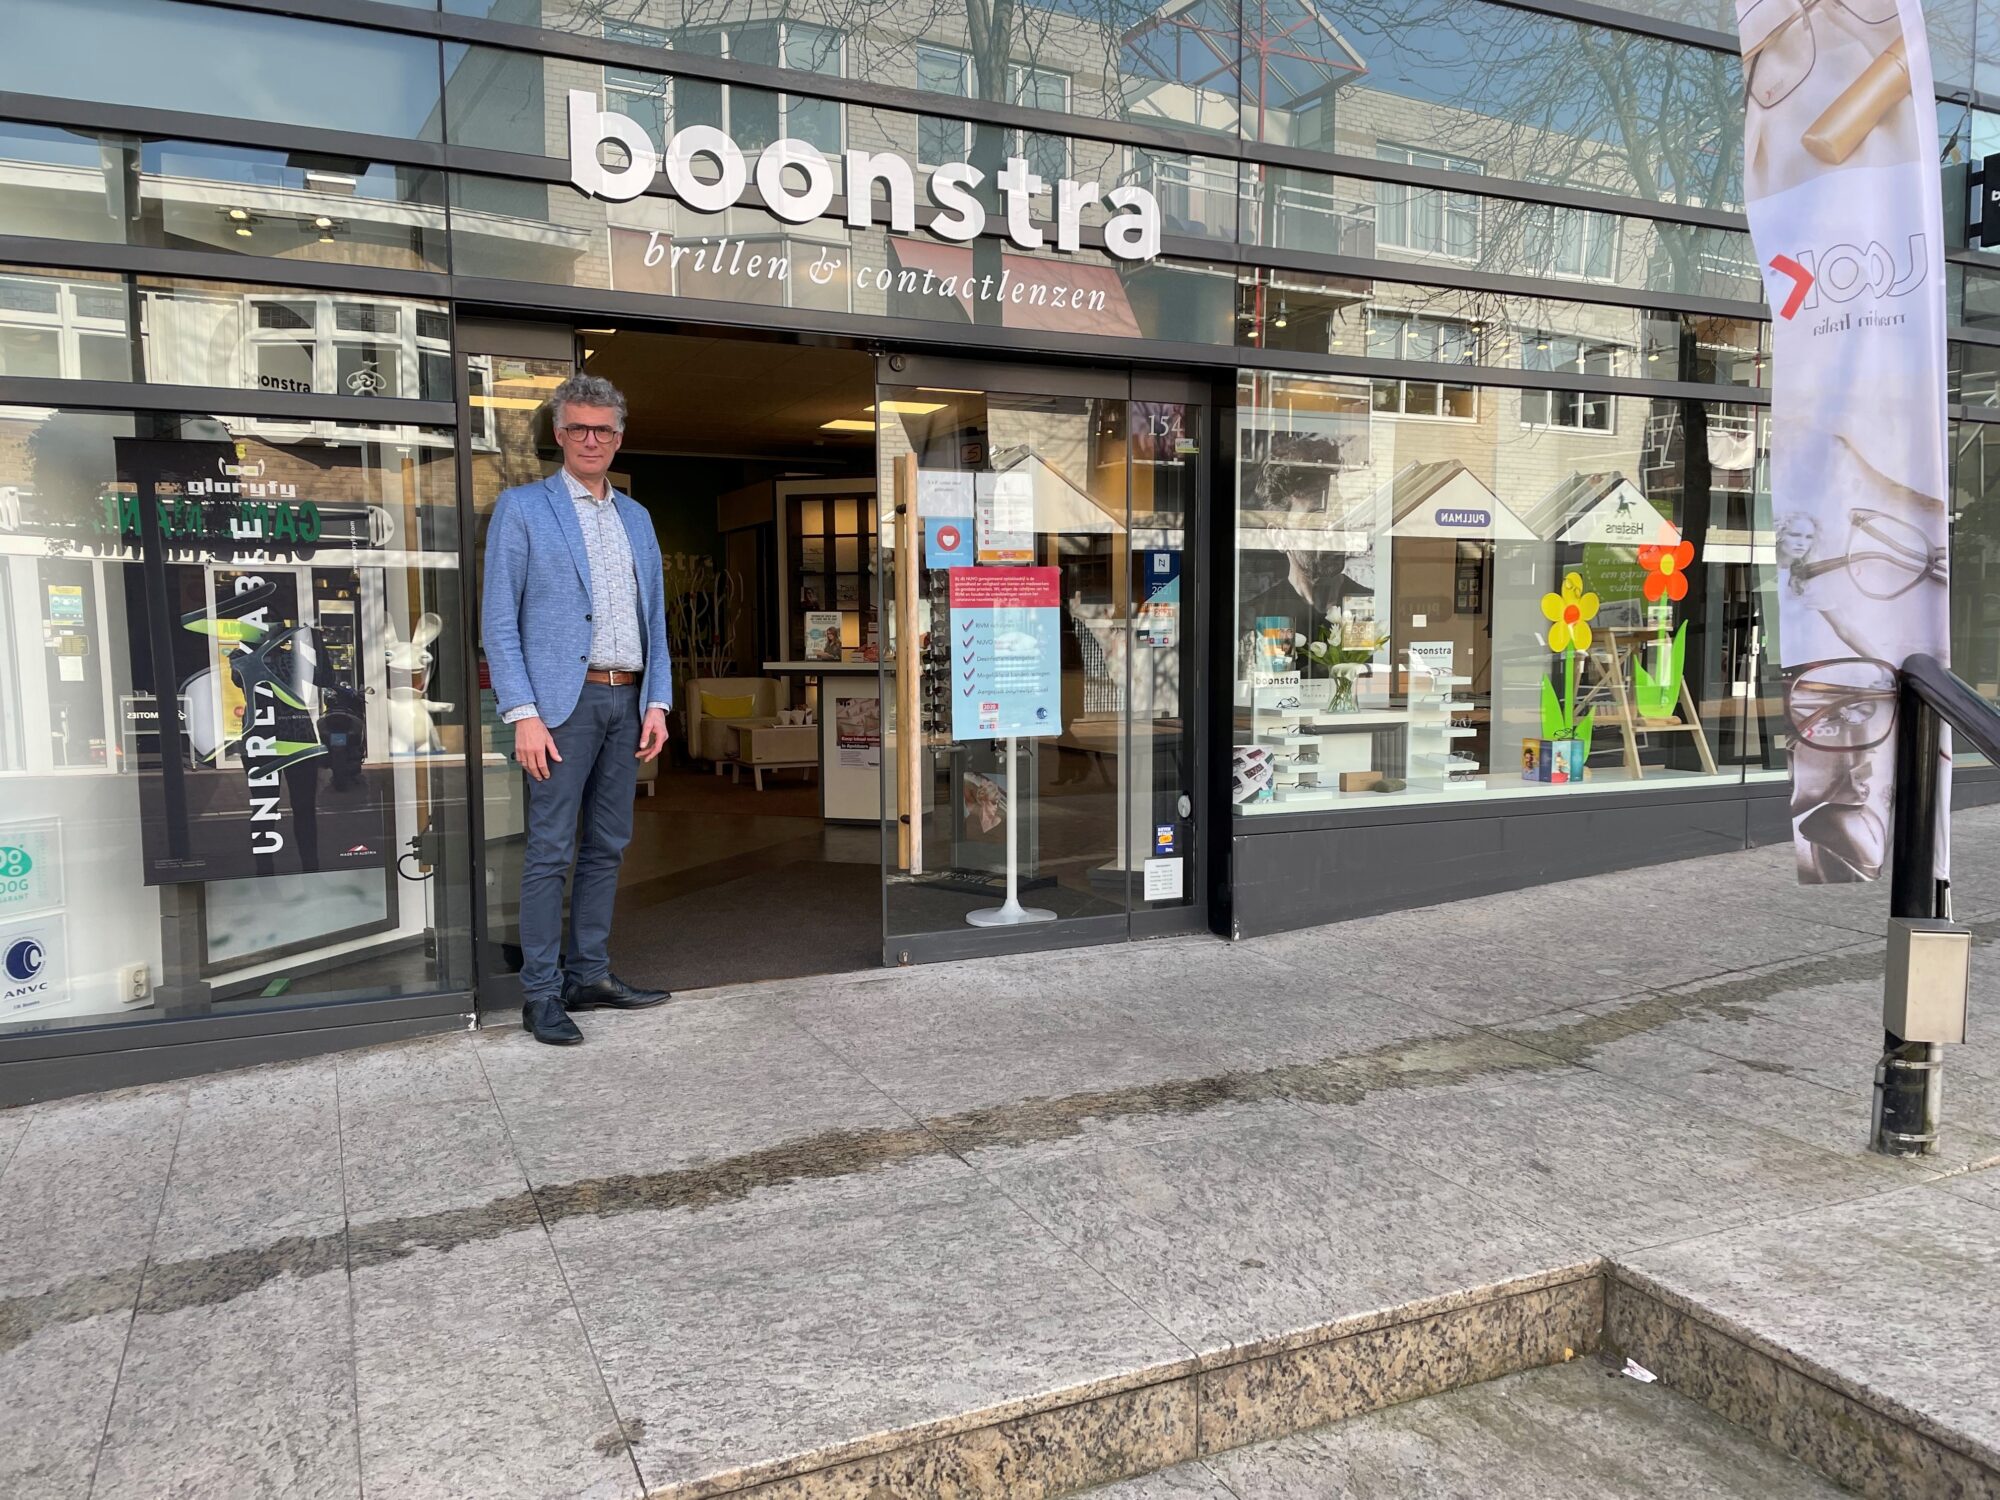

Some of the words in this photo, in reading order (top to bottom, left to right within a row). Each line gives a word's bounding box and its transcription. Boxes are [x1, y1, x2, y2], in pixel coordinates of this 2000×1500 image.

[568, 89, 1161, 261] boonstra
[643, 231, 789, 281] brillen
[809, 246, 841, 285] &
[856, 262, 1107, 311] contactlenzen
[1148, 414, 1183, 438] 154
[187, 478, 297, 498] gloryfy
[1412, 647, 1452, 655] boonstra
[1255, 677, 1299, 686] boonstra
[4, 982, 48, 999] ANVC
